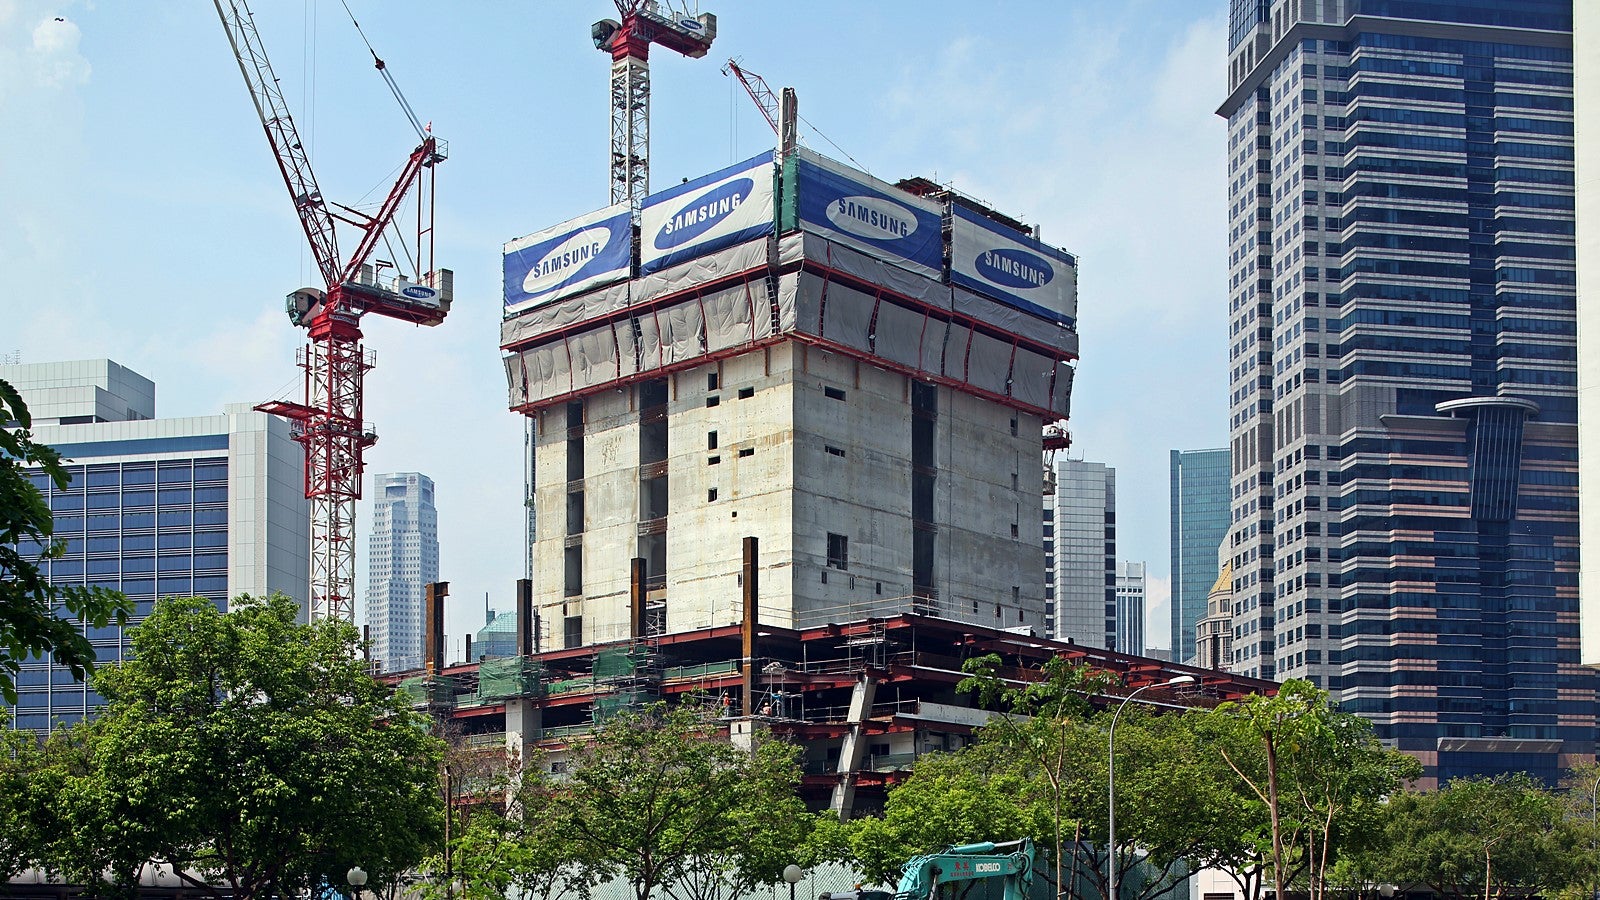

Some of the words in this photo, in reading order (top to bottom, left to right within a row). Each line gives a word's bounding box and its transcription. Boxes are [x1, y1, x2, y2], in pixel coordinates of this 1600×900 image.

[665, 193, 741, 235] SAMSUNG
[838, 197, 908, 239] SAMSUNG
[533, 242, 599, 279] SAMSUNG
[985, 250, 1045, 286] SAMSUNG
[975, 863, 1001, 872] KOBELCO
